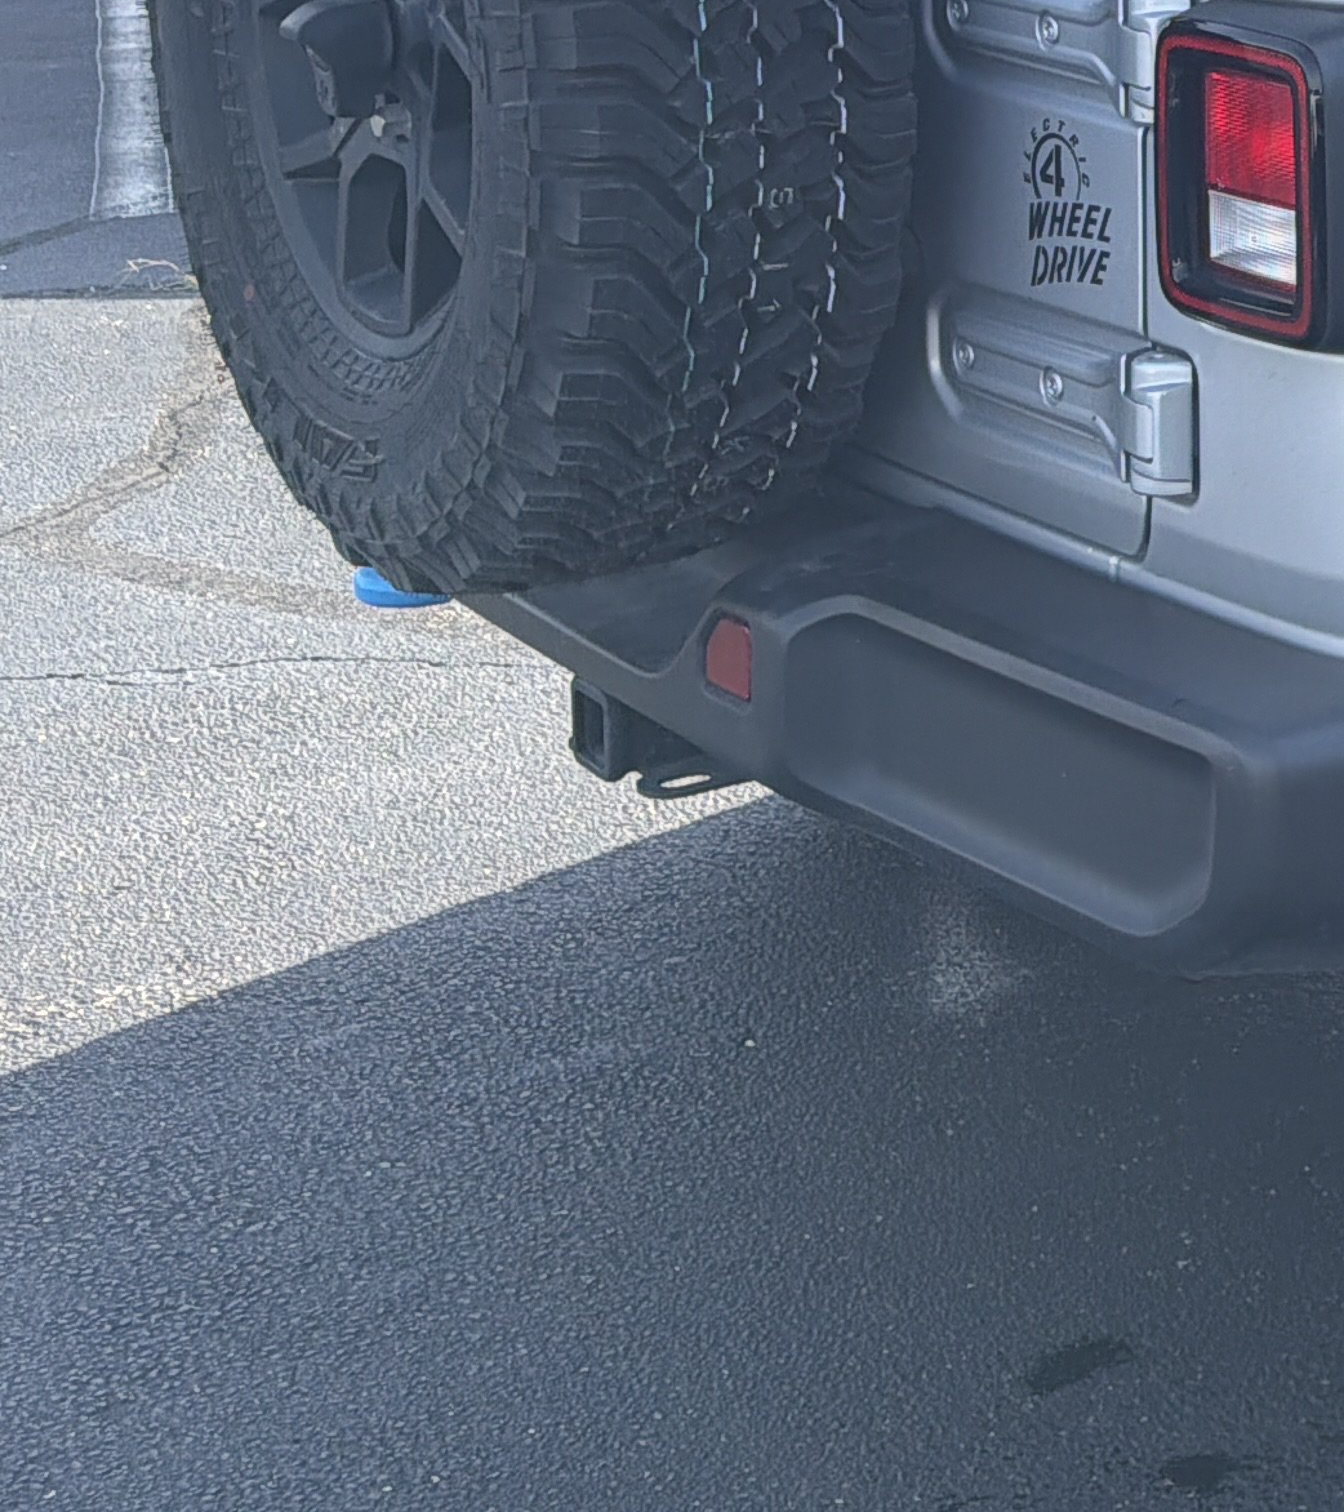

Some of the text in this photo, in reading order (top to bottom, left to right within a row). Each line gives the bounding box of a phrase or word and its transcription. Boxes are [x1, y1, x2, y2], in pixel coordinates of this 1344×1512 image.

[1022, 117, 1091, 189] ELECTRIC
[1039, 143, 1066, 197] 4
[1028, 201, 1112, 243] WHEEL
[1030, 245, 1111, 287] DRIVE
